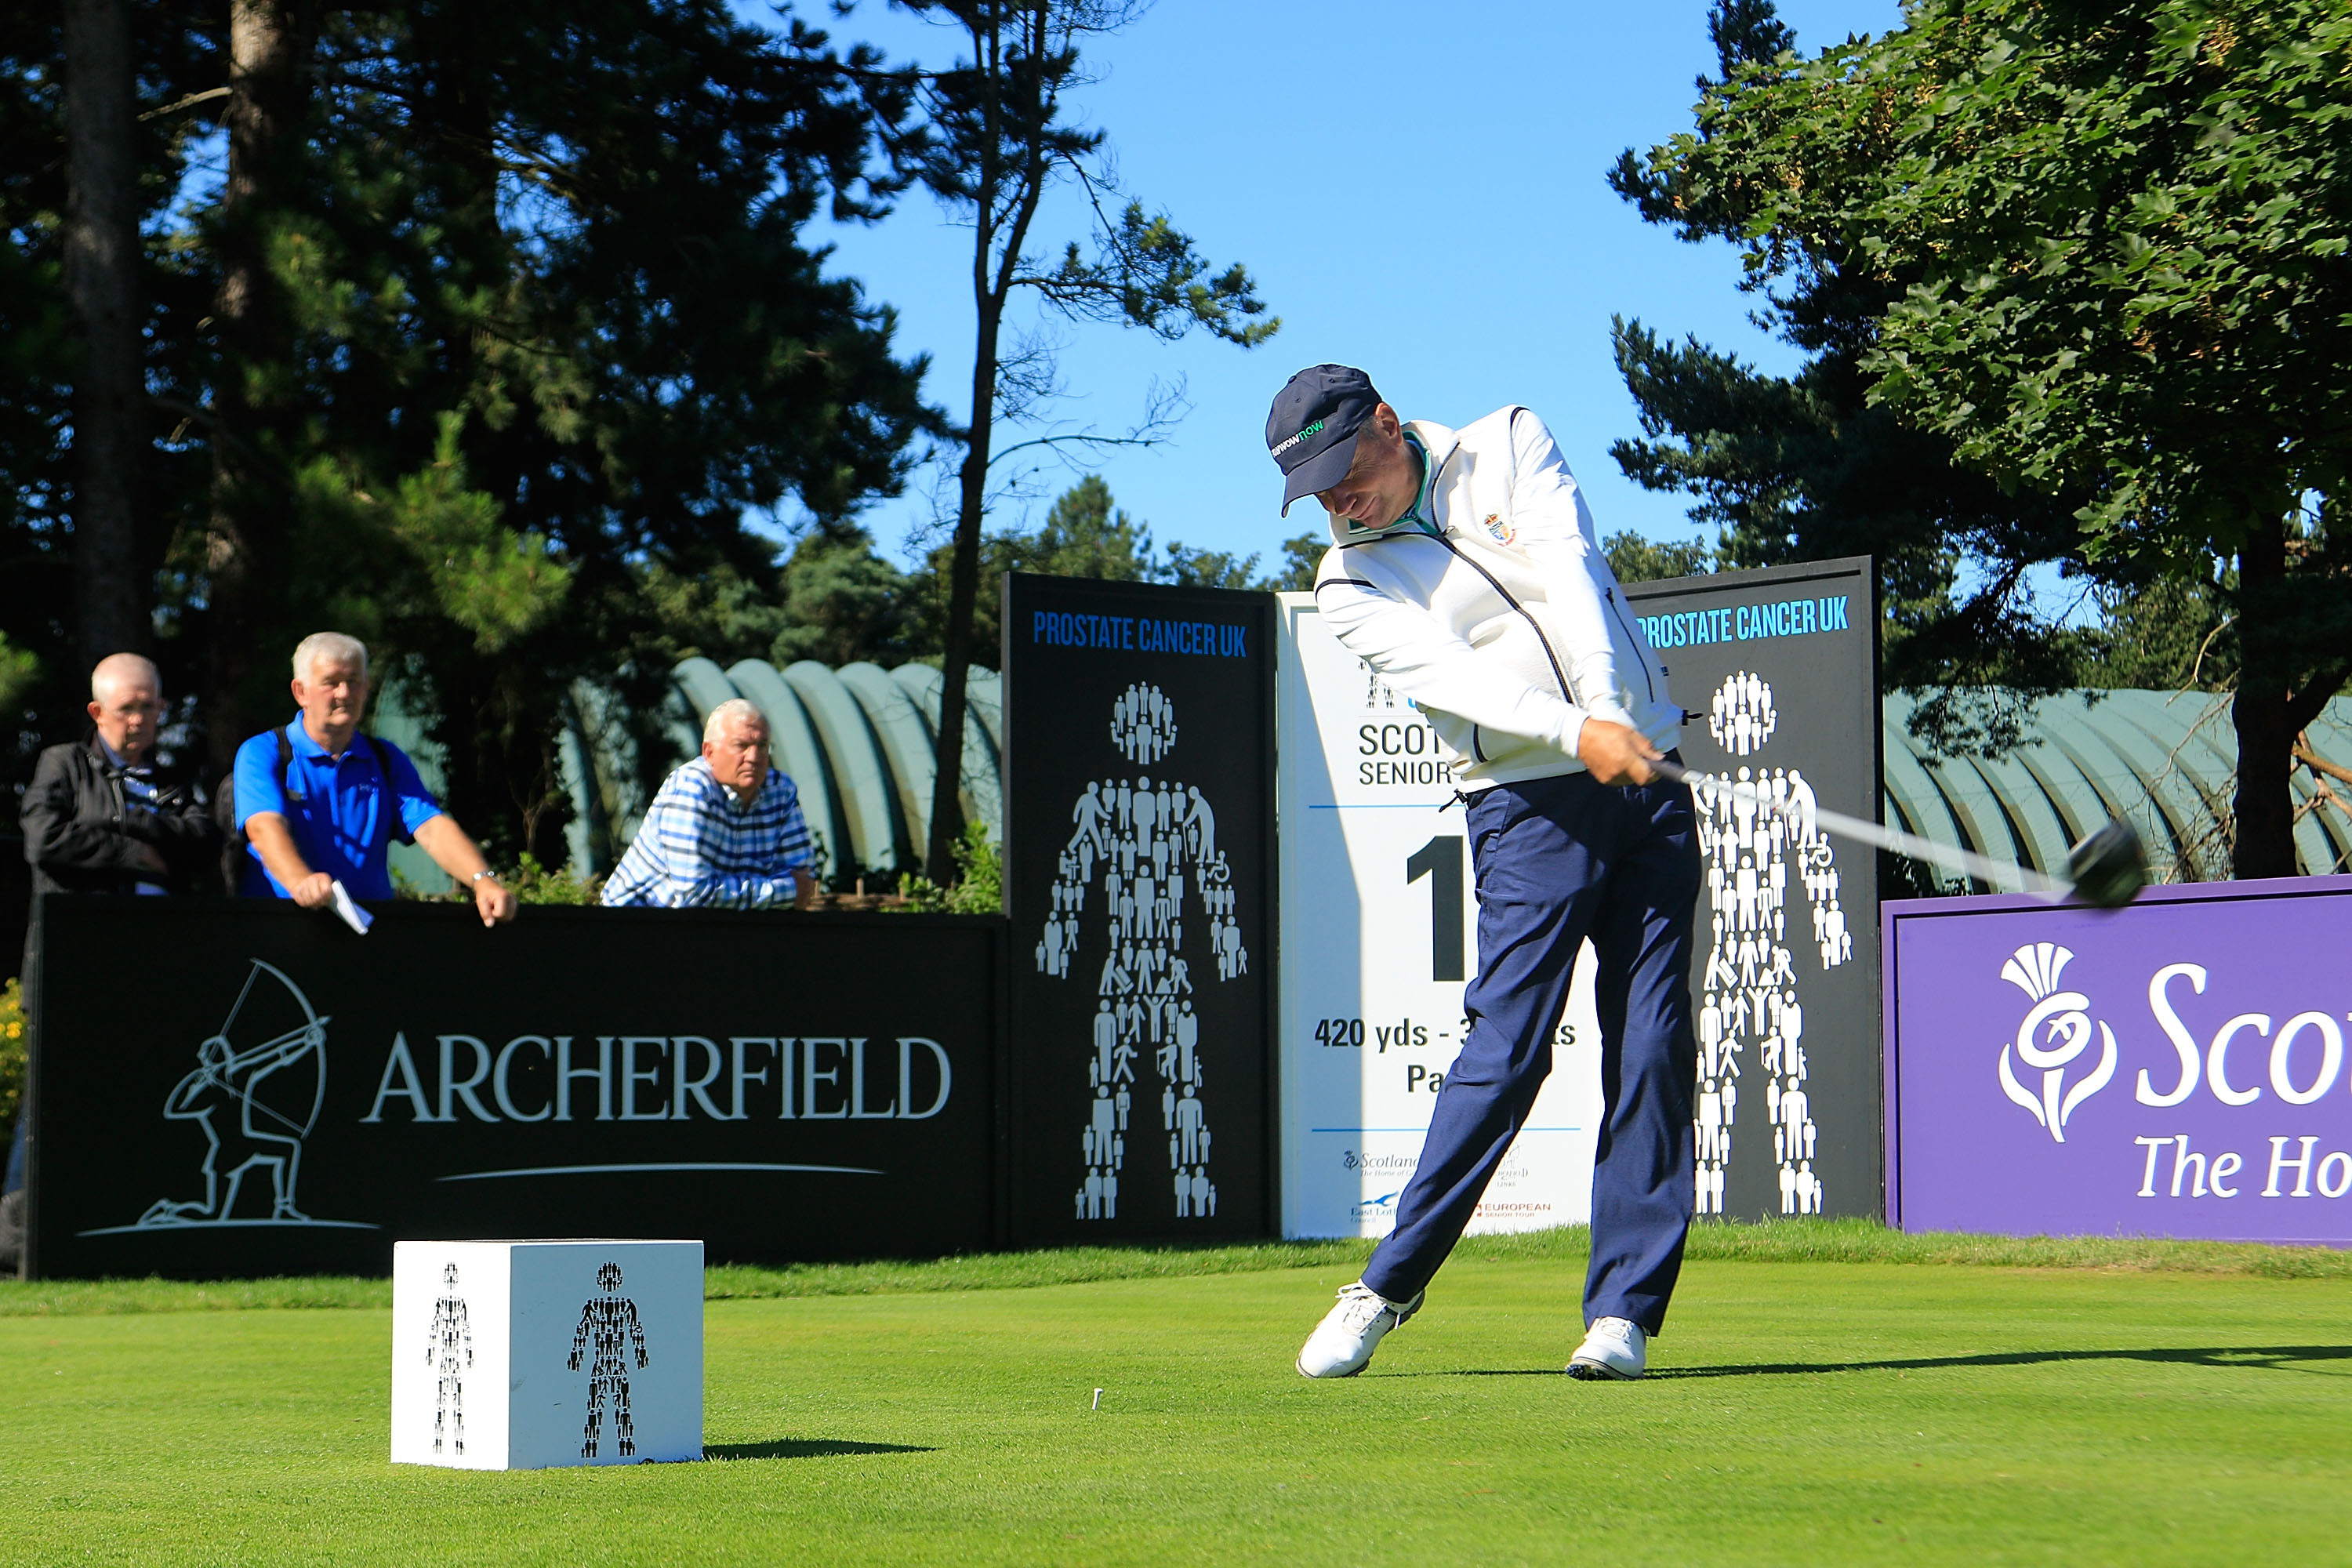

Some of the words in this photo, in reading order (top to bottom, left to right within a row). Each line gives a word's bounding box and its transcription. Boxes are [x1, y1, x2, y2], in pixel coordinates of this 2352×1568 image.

[1034, 610, 1134, 650] PROSTATE
[1138, 618, 1217, 655] CANCER
[1220, 624, 1247, 658] UK
[1736, 598, 1817, 641] CANCER
[1818, 595, 1849, 633] UK
[1359, 760, 1452, 785] SENIOR
[1407, 835, 1465, 982] 1
[1314, 1018, 1366, 1047] 420
[1375, 1018, 1428, 1054] yds
[2135, 962, 2352, 1107] Sco
[359, 1031, 953, 1123] ARCHERFIELD
[2133, 1134, 2243, 1199] The
[1351, 1207, 1373, 1217] East
